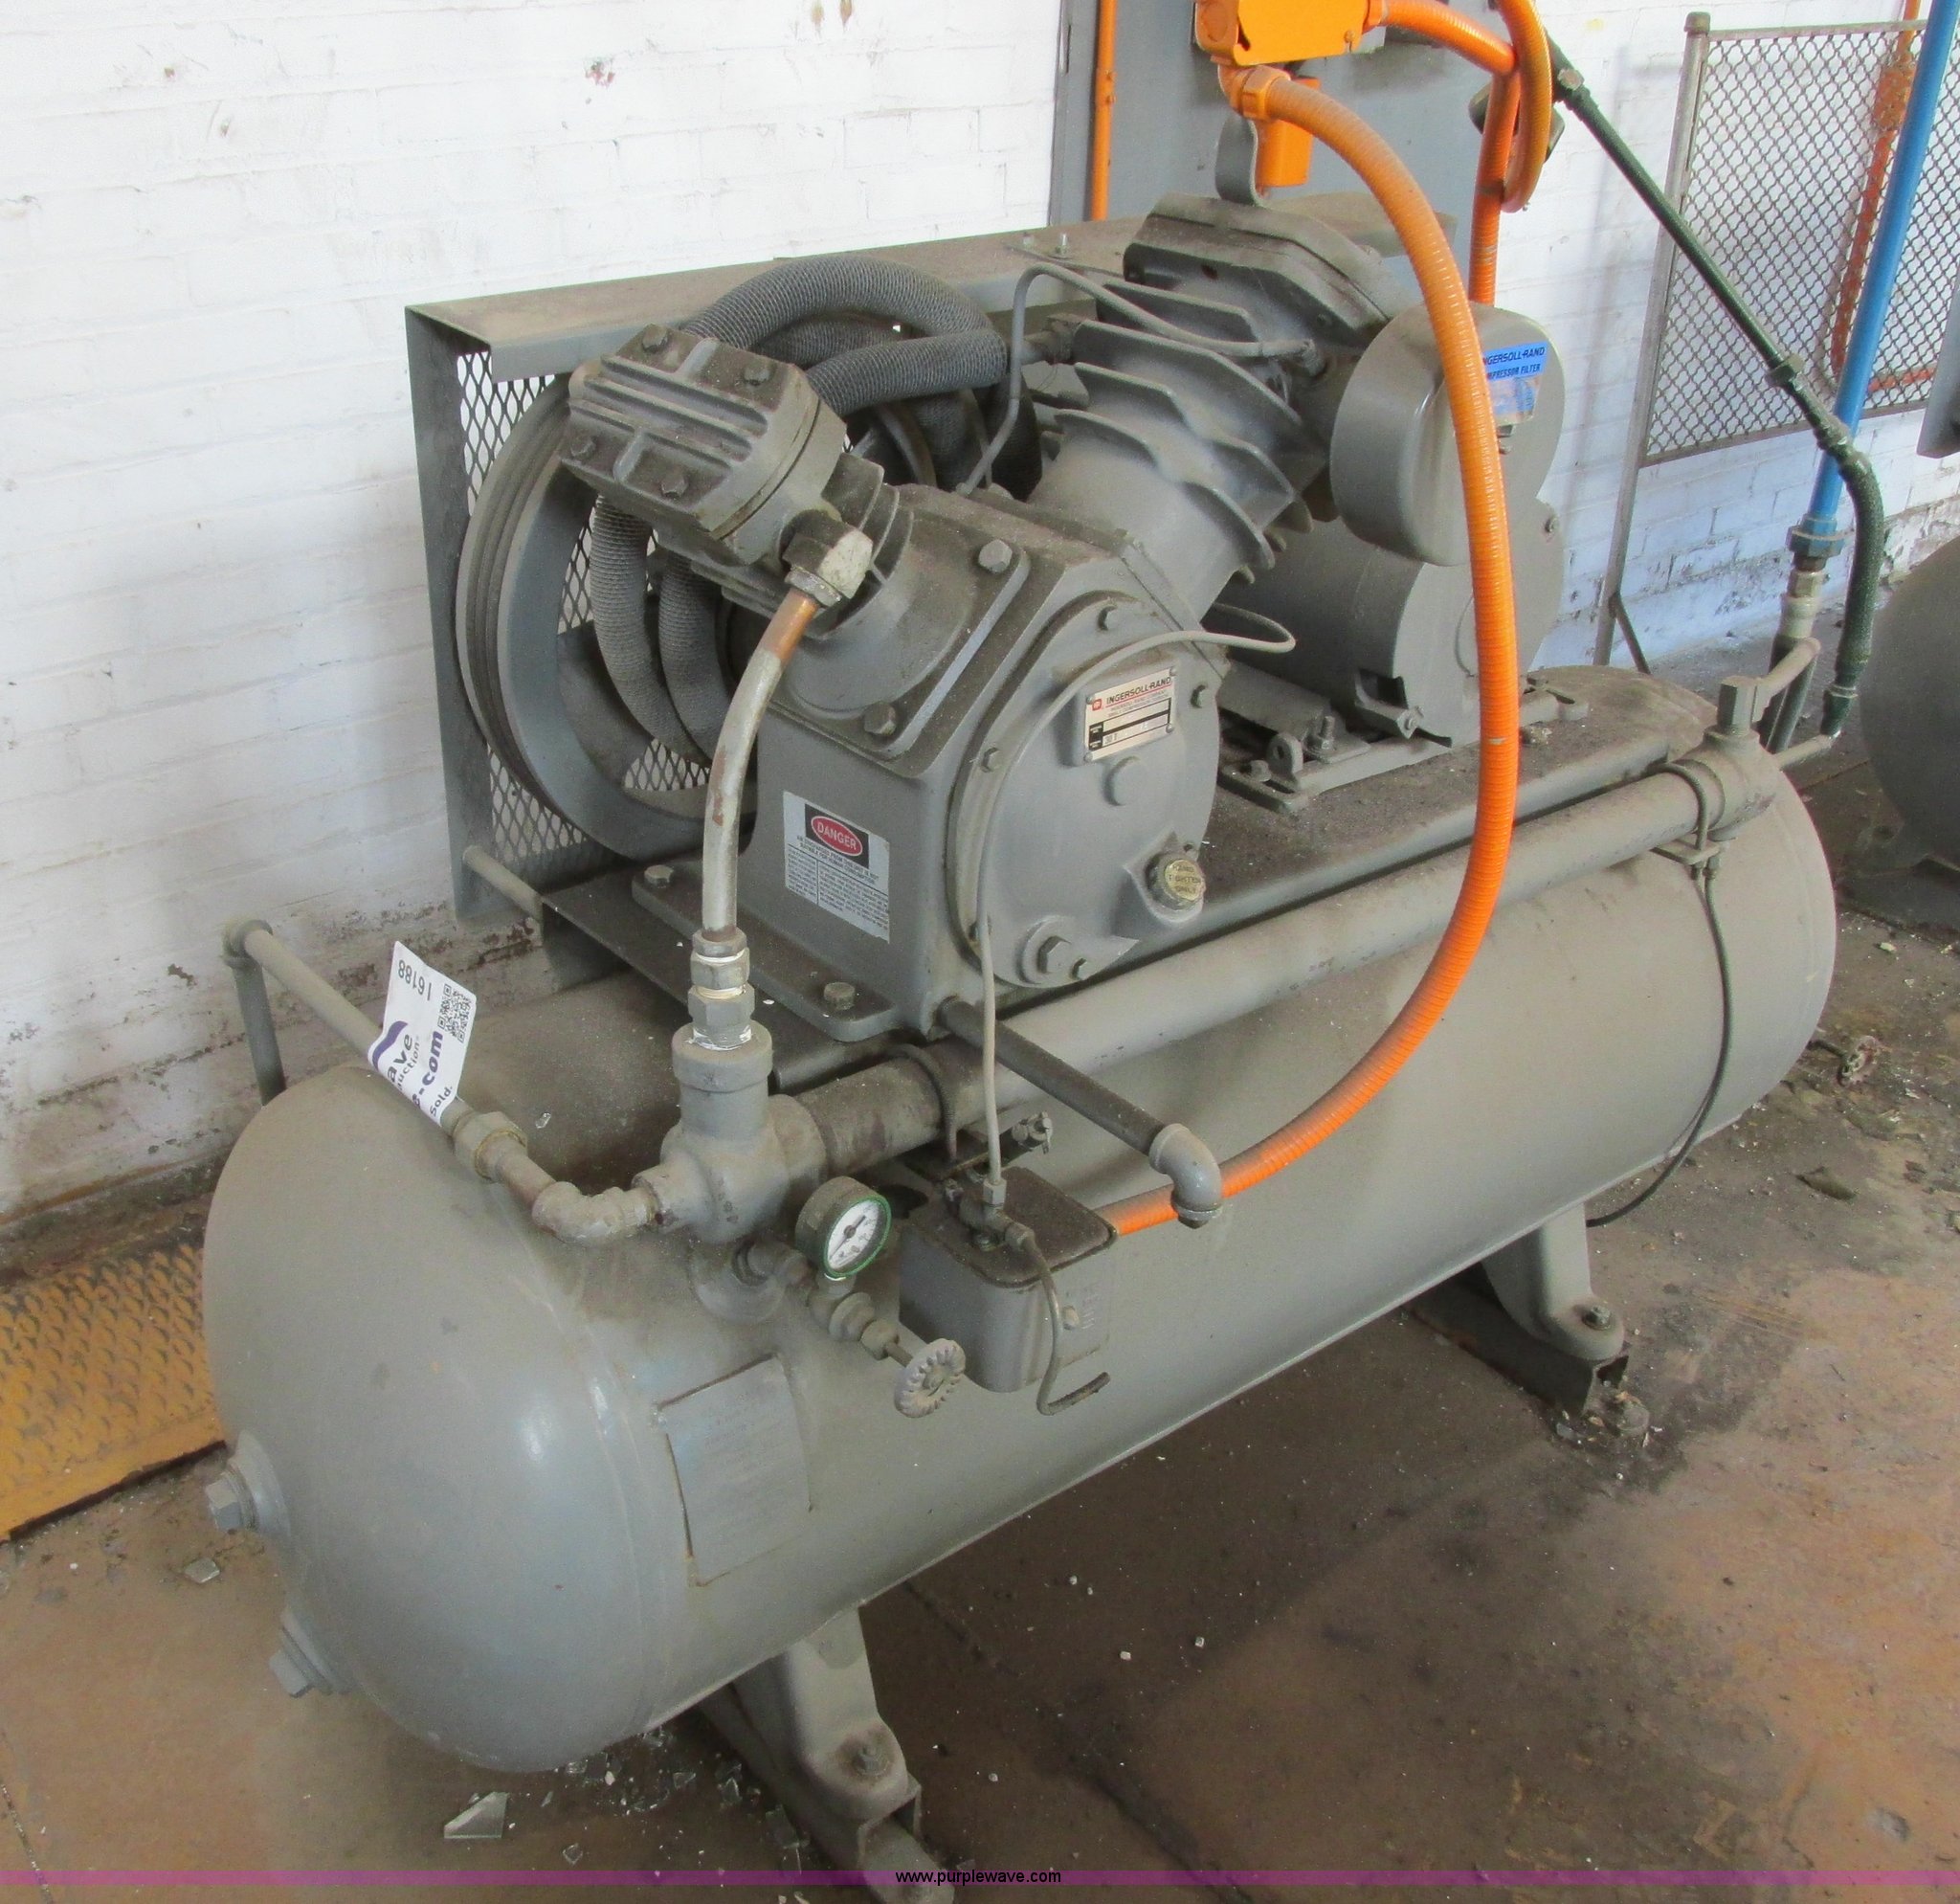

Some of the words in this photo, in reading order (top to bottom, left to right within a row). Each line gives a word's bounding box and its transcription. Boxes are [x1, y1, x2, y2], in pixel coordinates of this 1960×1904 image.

[1482, 347, 1546, 365] NGERSOLL-RAND
[1521, 364, 1541, 374] FILTER
[1106, 676, 1171, 705] INGERSOLL-RAND
[817, 821, 858, 851] DANGER
[388, 1034, 412, 1083] ave
[412, 1031, 443, 1109] e.com
